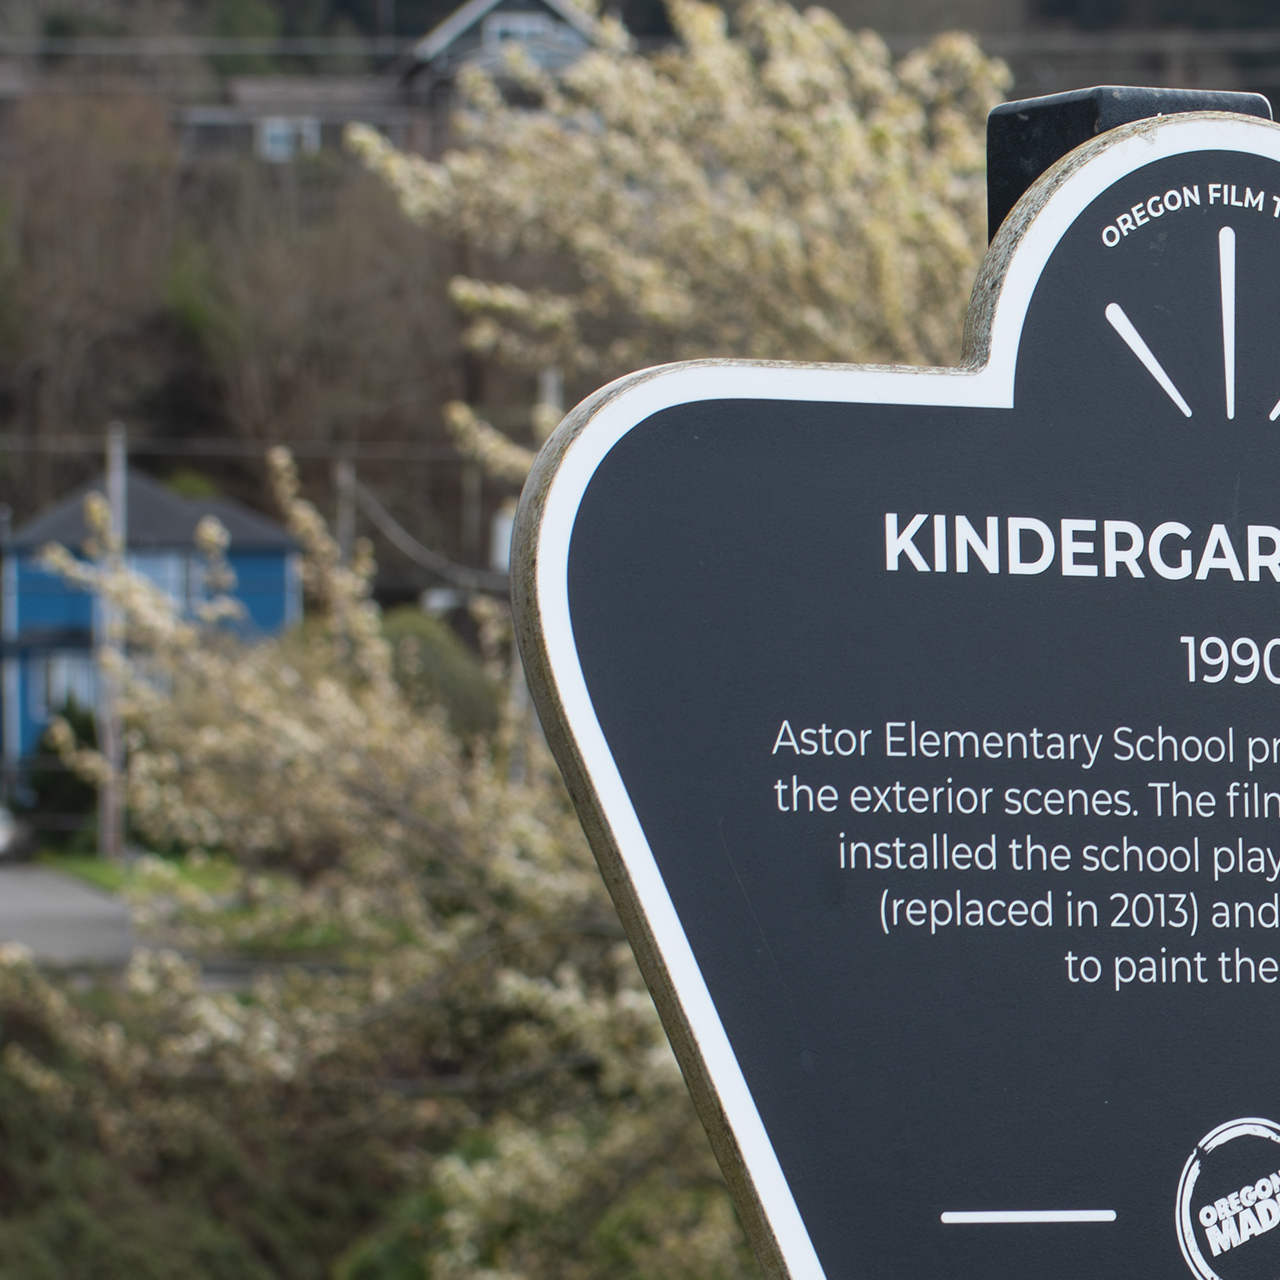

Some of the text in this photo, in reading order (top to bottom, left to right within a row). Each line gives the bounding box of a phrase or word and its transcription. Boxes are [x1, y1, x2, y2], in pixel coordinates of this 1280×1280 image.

[1101, 184, 1201, 248] OREGON
[1208, 184, 1264, 211] FILM
[772, 720, 872, 755] Astor
[886, 721, 1103, 769] Elementary
[1114, 726, 1233, 762] School
[774, 775, 838, 812] the
[851, 778, 993, 814] exterior
[1005, 788, 1138, 816] scenes.
[1148, 781, 1216, 817] The
[840, 832, 996, 870] installed
[1009, 835, 1071, 871] the
[1083, 836, 1199, 872] school
[881, 889, 1052, 934] (replaced
[1067, 891, 1097, 926] in
[1110, 892, 1198, 936] 2013)
[1212, 893, 1279, 928] and
[1065, 951, 1101, 982] to
[1115, 947, 1208, 991] paint
[1218, 948, 1278, 983] the
